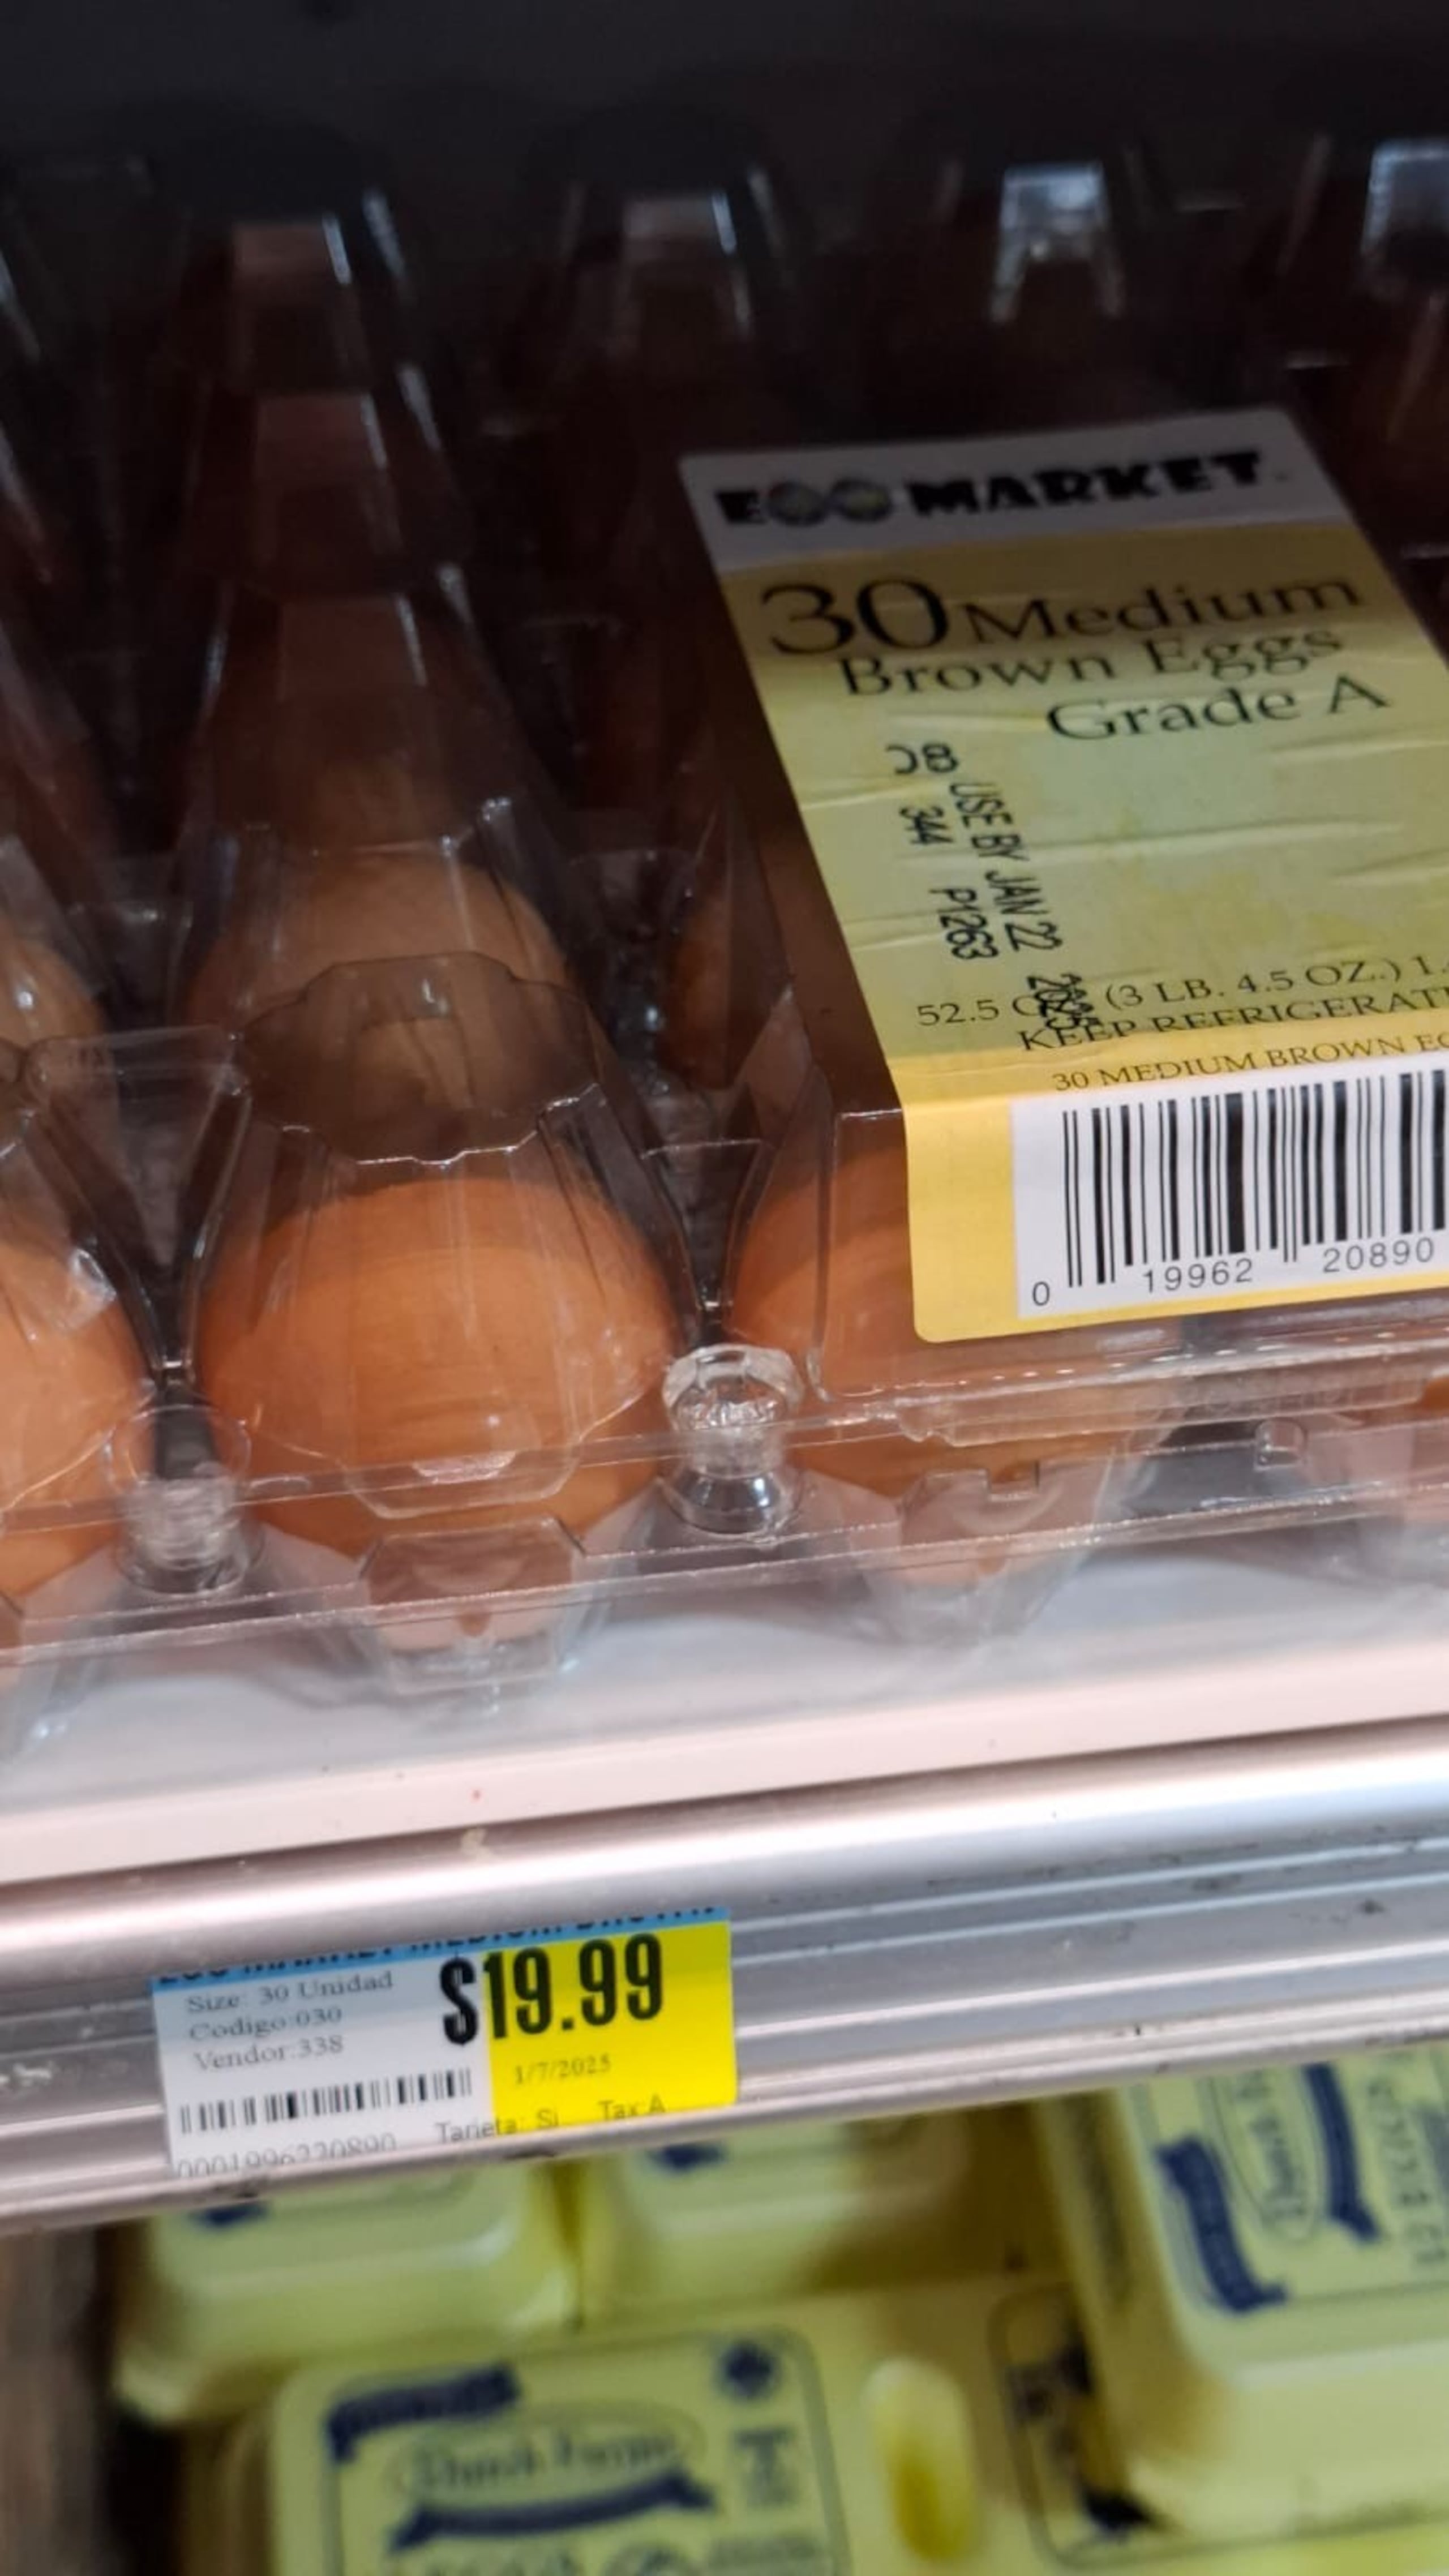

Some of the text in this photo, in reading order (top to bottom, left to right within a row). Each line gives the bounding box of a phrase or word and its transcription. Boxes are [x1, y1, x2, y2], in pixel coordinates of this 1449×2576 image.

[907, 451, 1261, 516] MARKET
[762, 574, 1365, 654] 30 Medium
[839, 625, 1345, 696] Brown Eggs
[1046, 674, 1390, 741] Grade A
[949, 783, 1014, 828] USE
[970, 833, 1031, 862] BY
[899, 805, 1000, 961] 344 P1263
[984, 870, 1052, 916] JAN
[1004, 920, 1064, 953] 22
[916, 998, 1000, 1027] 52.5
[1105, 983, 1143, 1011] (3
[1156, 978, 1224, 1004] LB.
[1237, 970, 1294, 995] 4.5
[1304, 958, 1401, 987] OZ.)
[1412, 955, 1449, 976] 1.
[1018, 986, 1449, 1051] KEEP REFRIGERAT
[1054, 1071, 1089, 1091] 30
[1098, 1051, 1258, 1086] MEDIUM
[1265, 1035, 1406, 1068] BROWN
[1031, 1236, 1435, 1306] 0 19962 20890
[259, 1985, 290, 2005] 30
[298, 1970, 394, 1999] Unidad
[439, 1932, 663, 2047] $19.99
[515, 2053, 612, 2085] 1/7/2025
